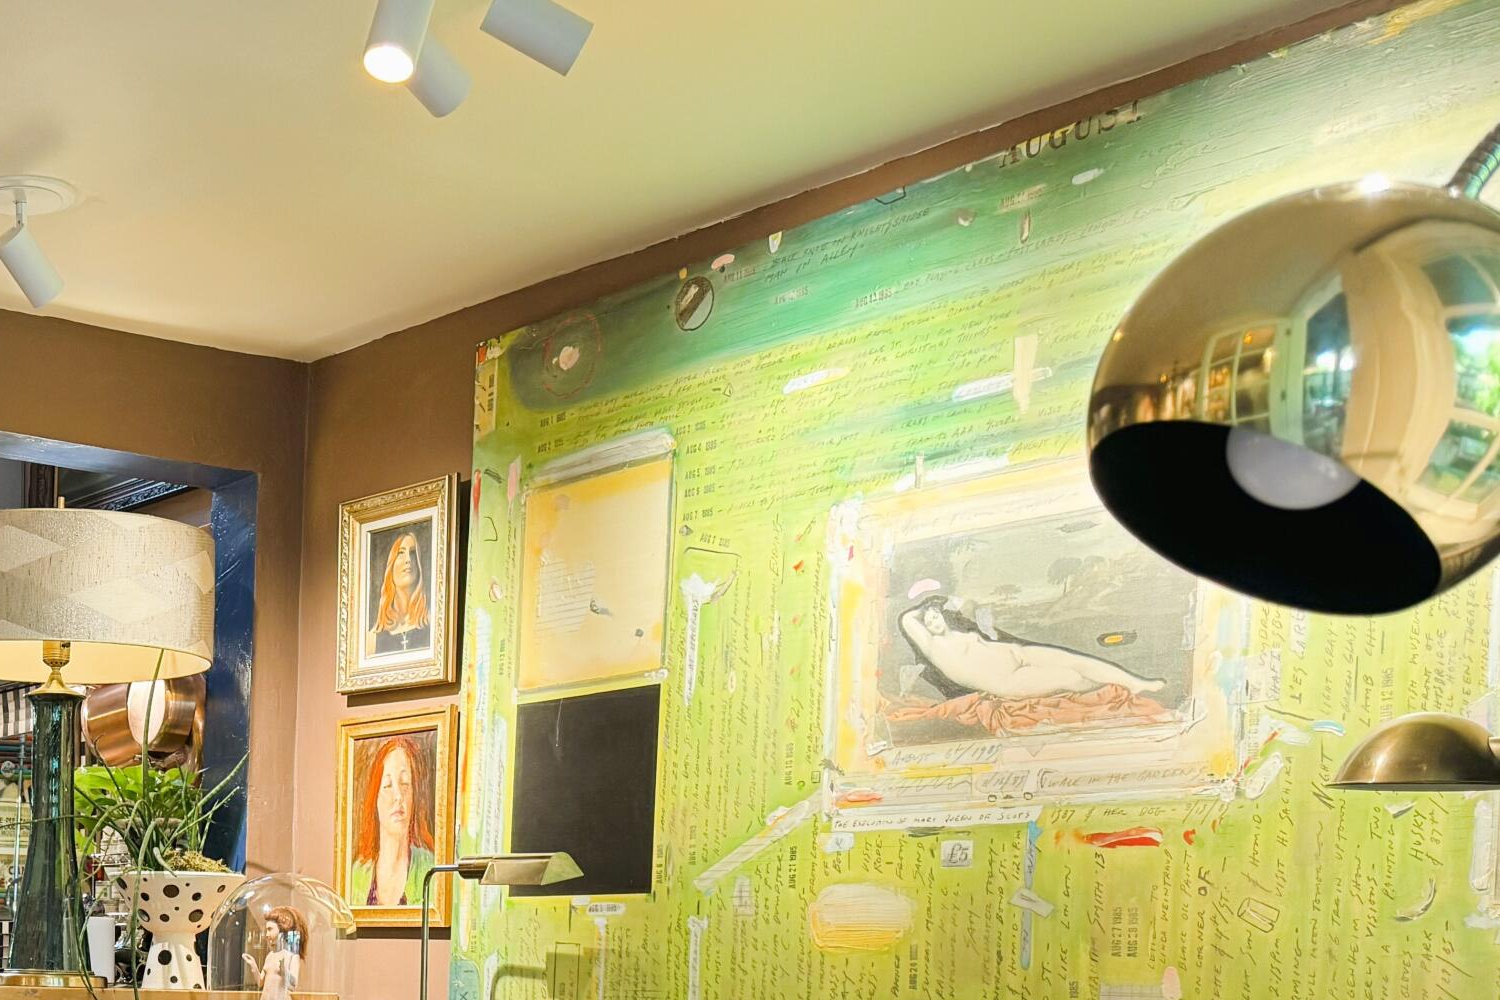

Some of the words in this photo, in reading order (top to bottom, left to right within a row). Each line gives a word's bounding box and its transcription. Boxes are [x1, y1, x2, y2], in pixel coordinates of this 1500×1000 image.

[1343, 623, 1356, 665] GLASS
[1380, 666, 1394, 688] 1985
[1380, 688, 1394, 701] 12
[833, 819, 850, 829] THE
[943, 814, 973, 824] QUEEN
[978, 813, 991, 822] OF
[1368, 805, 1383, 841] TWO
[1408, 808, 1425, 862] HUSKY
[945, 842, 970, 865] £5
[787, 873, 797, 890] AUG
[1179, 849, 1193, 898] PAINT
[1196, 865, 1214, 898] OF
[1150, 884, 1158, 903] TO
[1086, 882, 1106, 934] SMITH
[1110, 906, 1122, 926] 1985
[1126, 906, 1138, 926] 1985
[1364, 875, 1378, 938] VISIONS
[1110, 925, 1122, 938] 27
[1195, 910, 1206, 969] CORNER
[1110, 938, 1122, 959] AUG
[1126, 938, 1138, 959] AUG
[1379, 943, 1392, 954] A
[1419, 928, 1434, 973] PARK
[1058, 941, 1069, 981] LIKE
[1068, 980, 1080, 1000] 1985
[1194, 976, 1203, 995] ON
